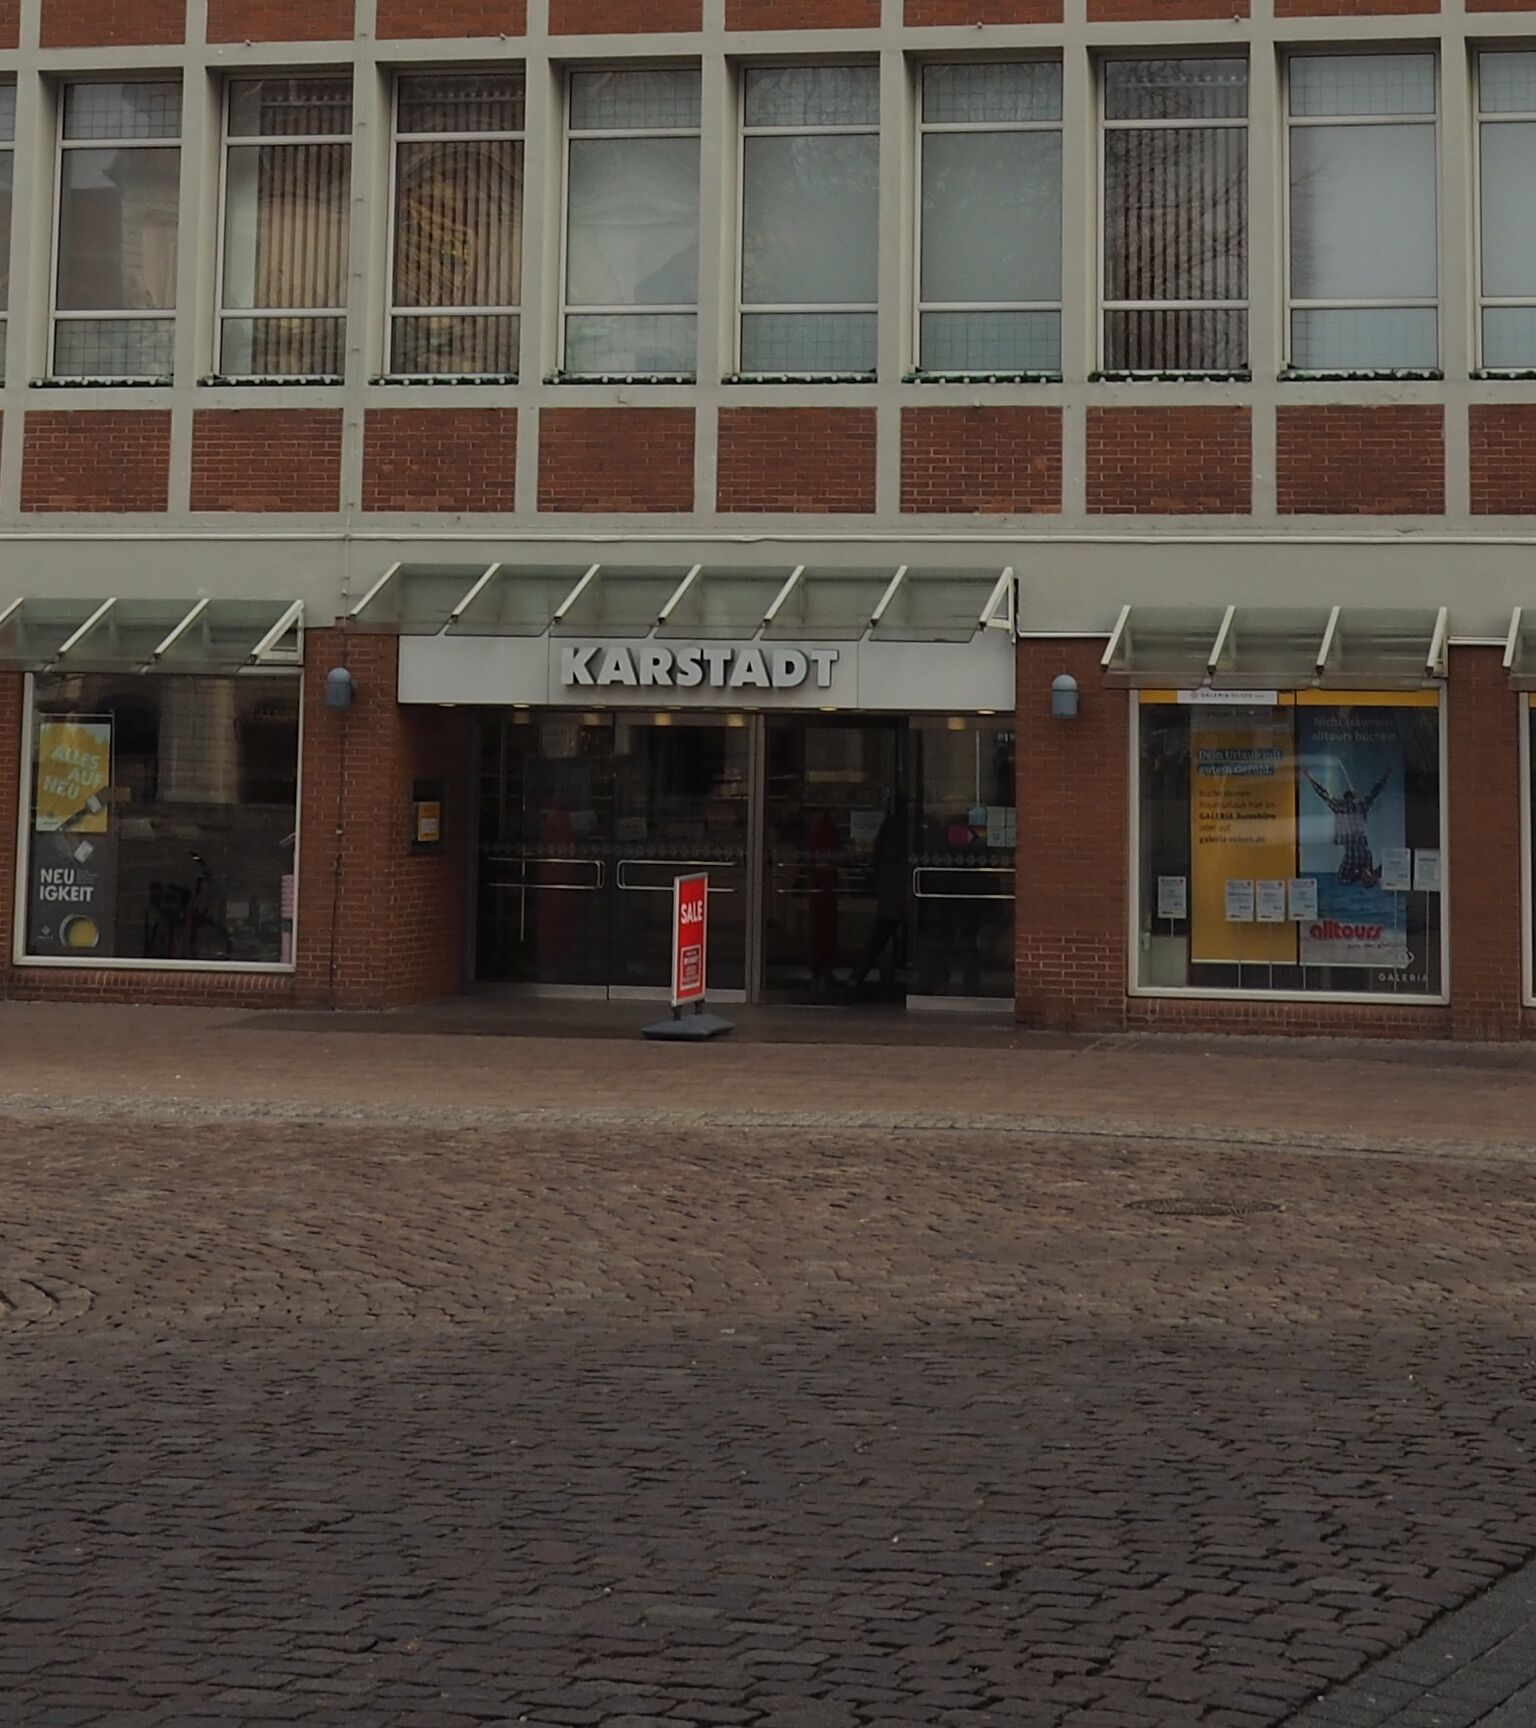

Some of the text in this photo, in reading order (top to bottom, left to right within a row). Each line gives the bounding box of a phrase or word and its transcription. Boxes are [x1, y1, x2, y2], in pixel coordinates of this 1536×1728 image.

[560, 646, 841, 688] KARSTADT
[51, 746, 100, 770] ALLES
[44, 776, 81, 800] NEU
[40, 868, 75, 885] NEU
[39, 885, 95, 902] IGKEIT
[681, 900, 703, 924] SALE
[1310, 921, 1383, 941] alltours
[1378, 973, 1428, 982] GALERIA
